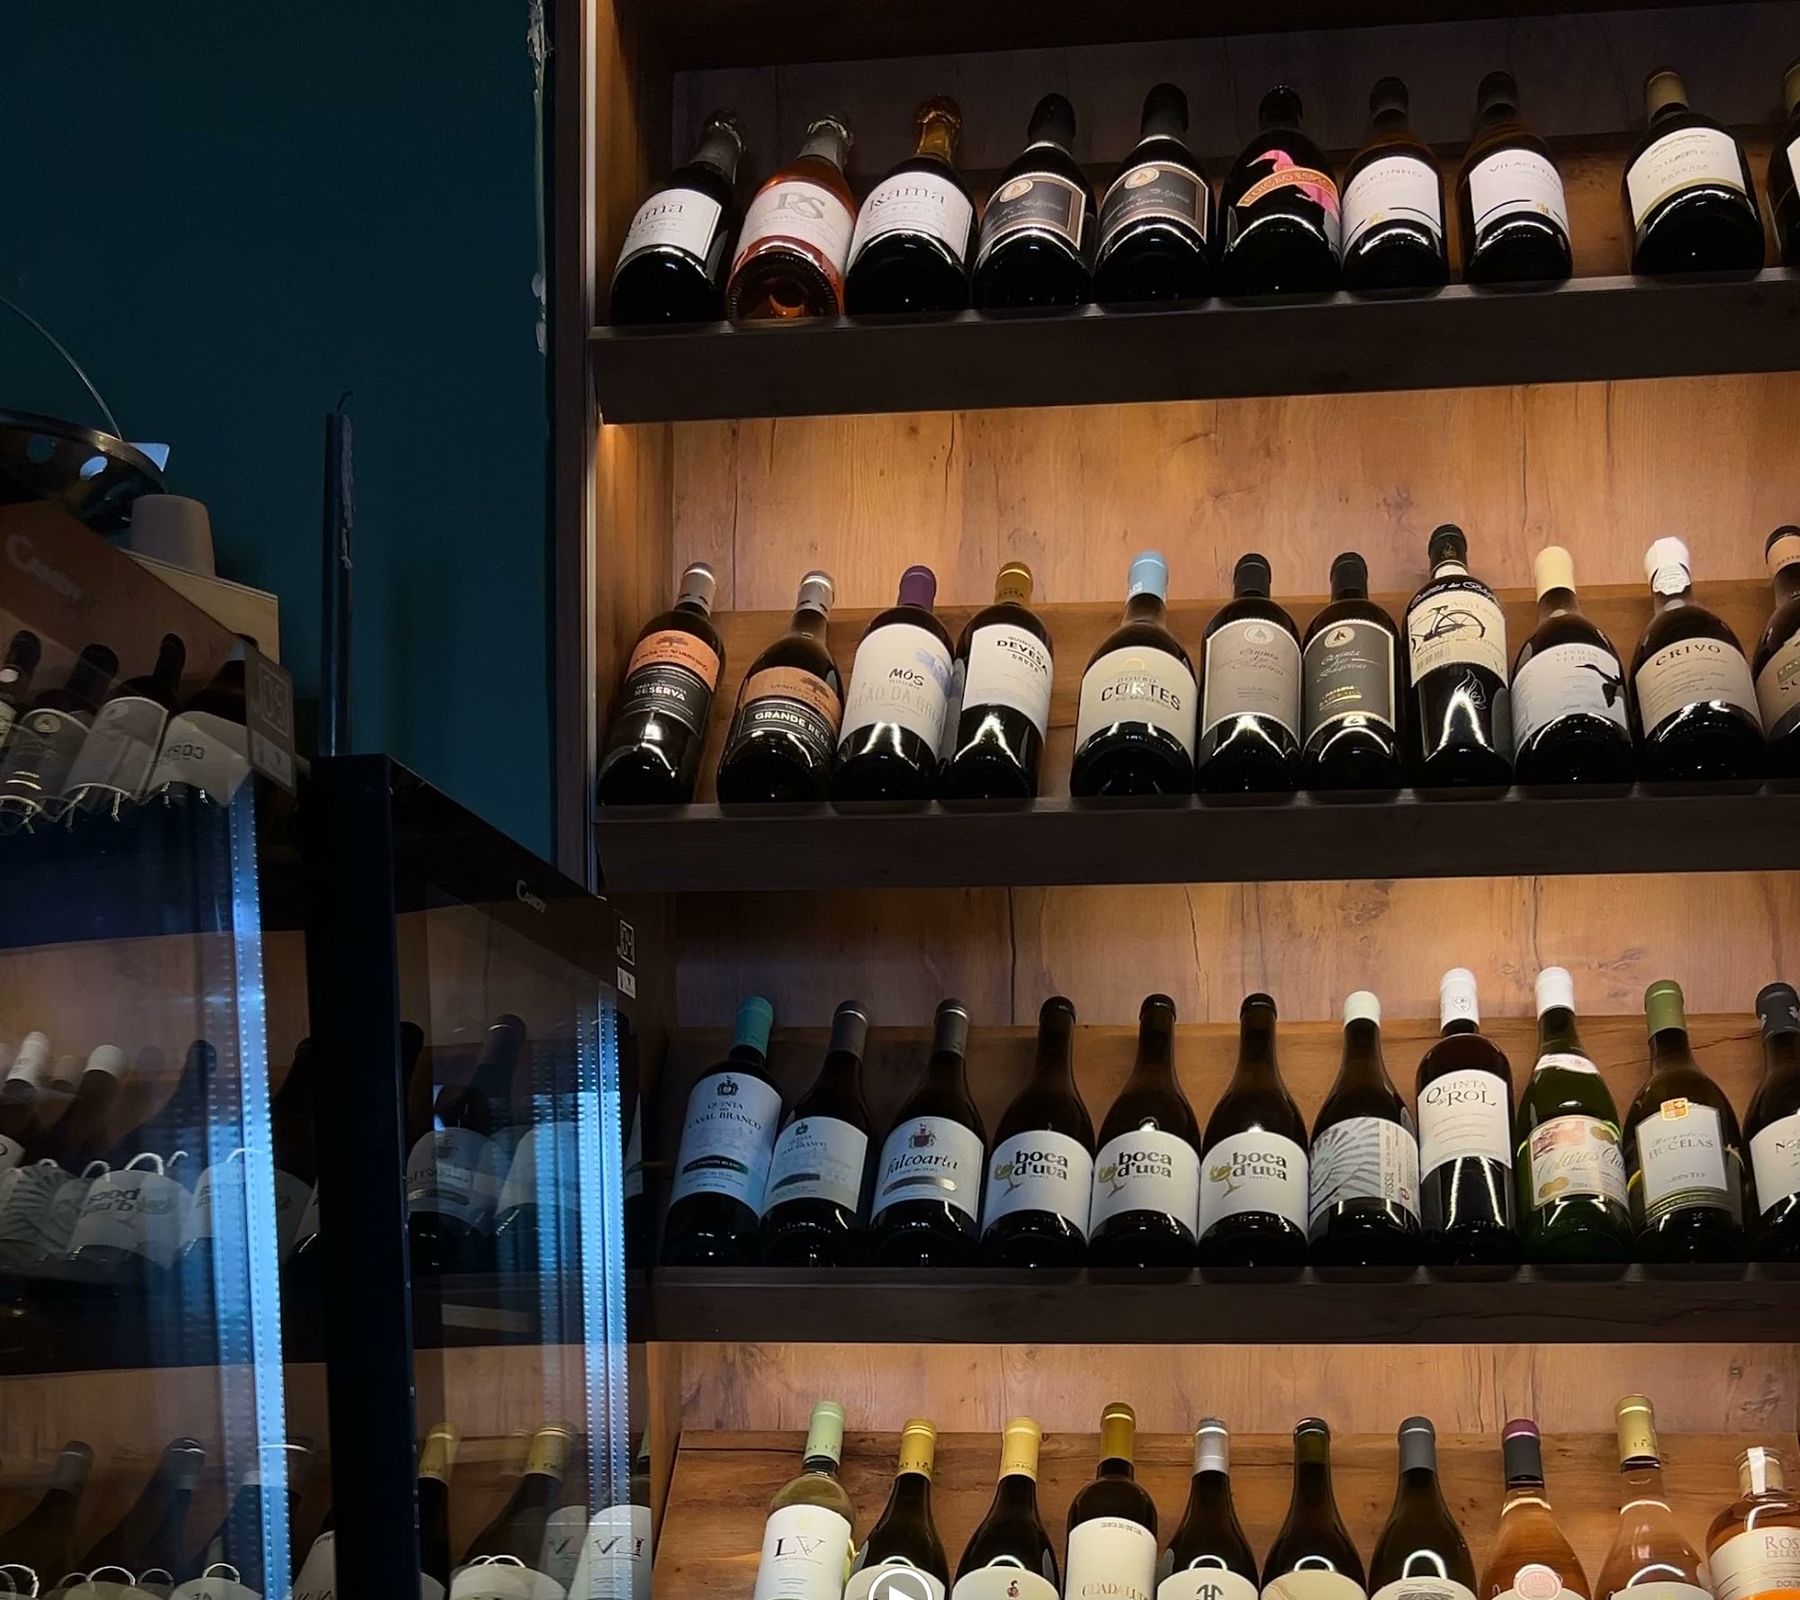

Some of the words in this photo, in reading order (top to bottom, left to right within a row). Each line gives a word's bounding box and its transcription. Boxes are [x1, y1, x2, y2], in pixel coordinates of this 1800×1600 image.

[870, 186, 945, 211] Rama
[997, 640, 1048, 676] DEVESA
[1655, 643, 1721, 666] CRIVO
[634, 686, 686, 701] RESERVA
[1101, 681, 1181, 711] CORTES
[754, 711, 807, 727] GRANDE
[1446, 1090, 1497, 1107] ROL
[719, 1112, 762, 1130] BRANCO
[1015, 1150, 1069, 1169] boca
[1118, 1151, 1172, 1167] boca
[1232, 1151, 1287, 1169] boca
[881, 1153, 958, 1186] falcoaria
[1013, 1161, 1068, 1181] d'uva
[1117, 1162, 1172, 1178] d'uva
[1232, 1162, 1288, 1181] d'uva
[773, 1535, 826, 1558] LV
[1765, 1536, 1800, 1550] ROS
[1776, 1580, 1800, 1588] DOU
